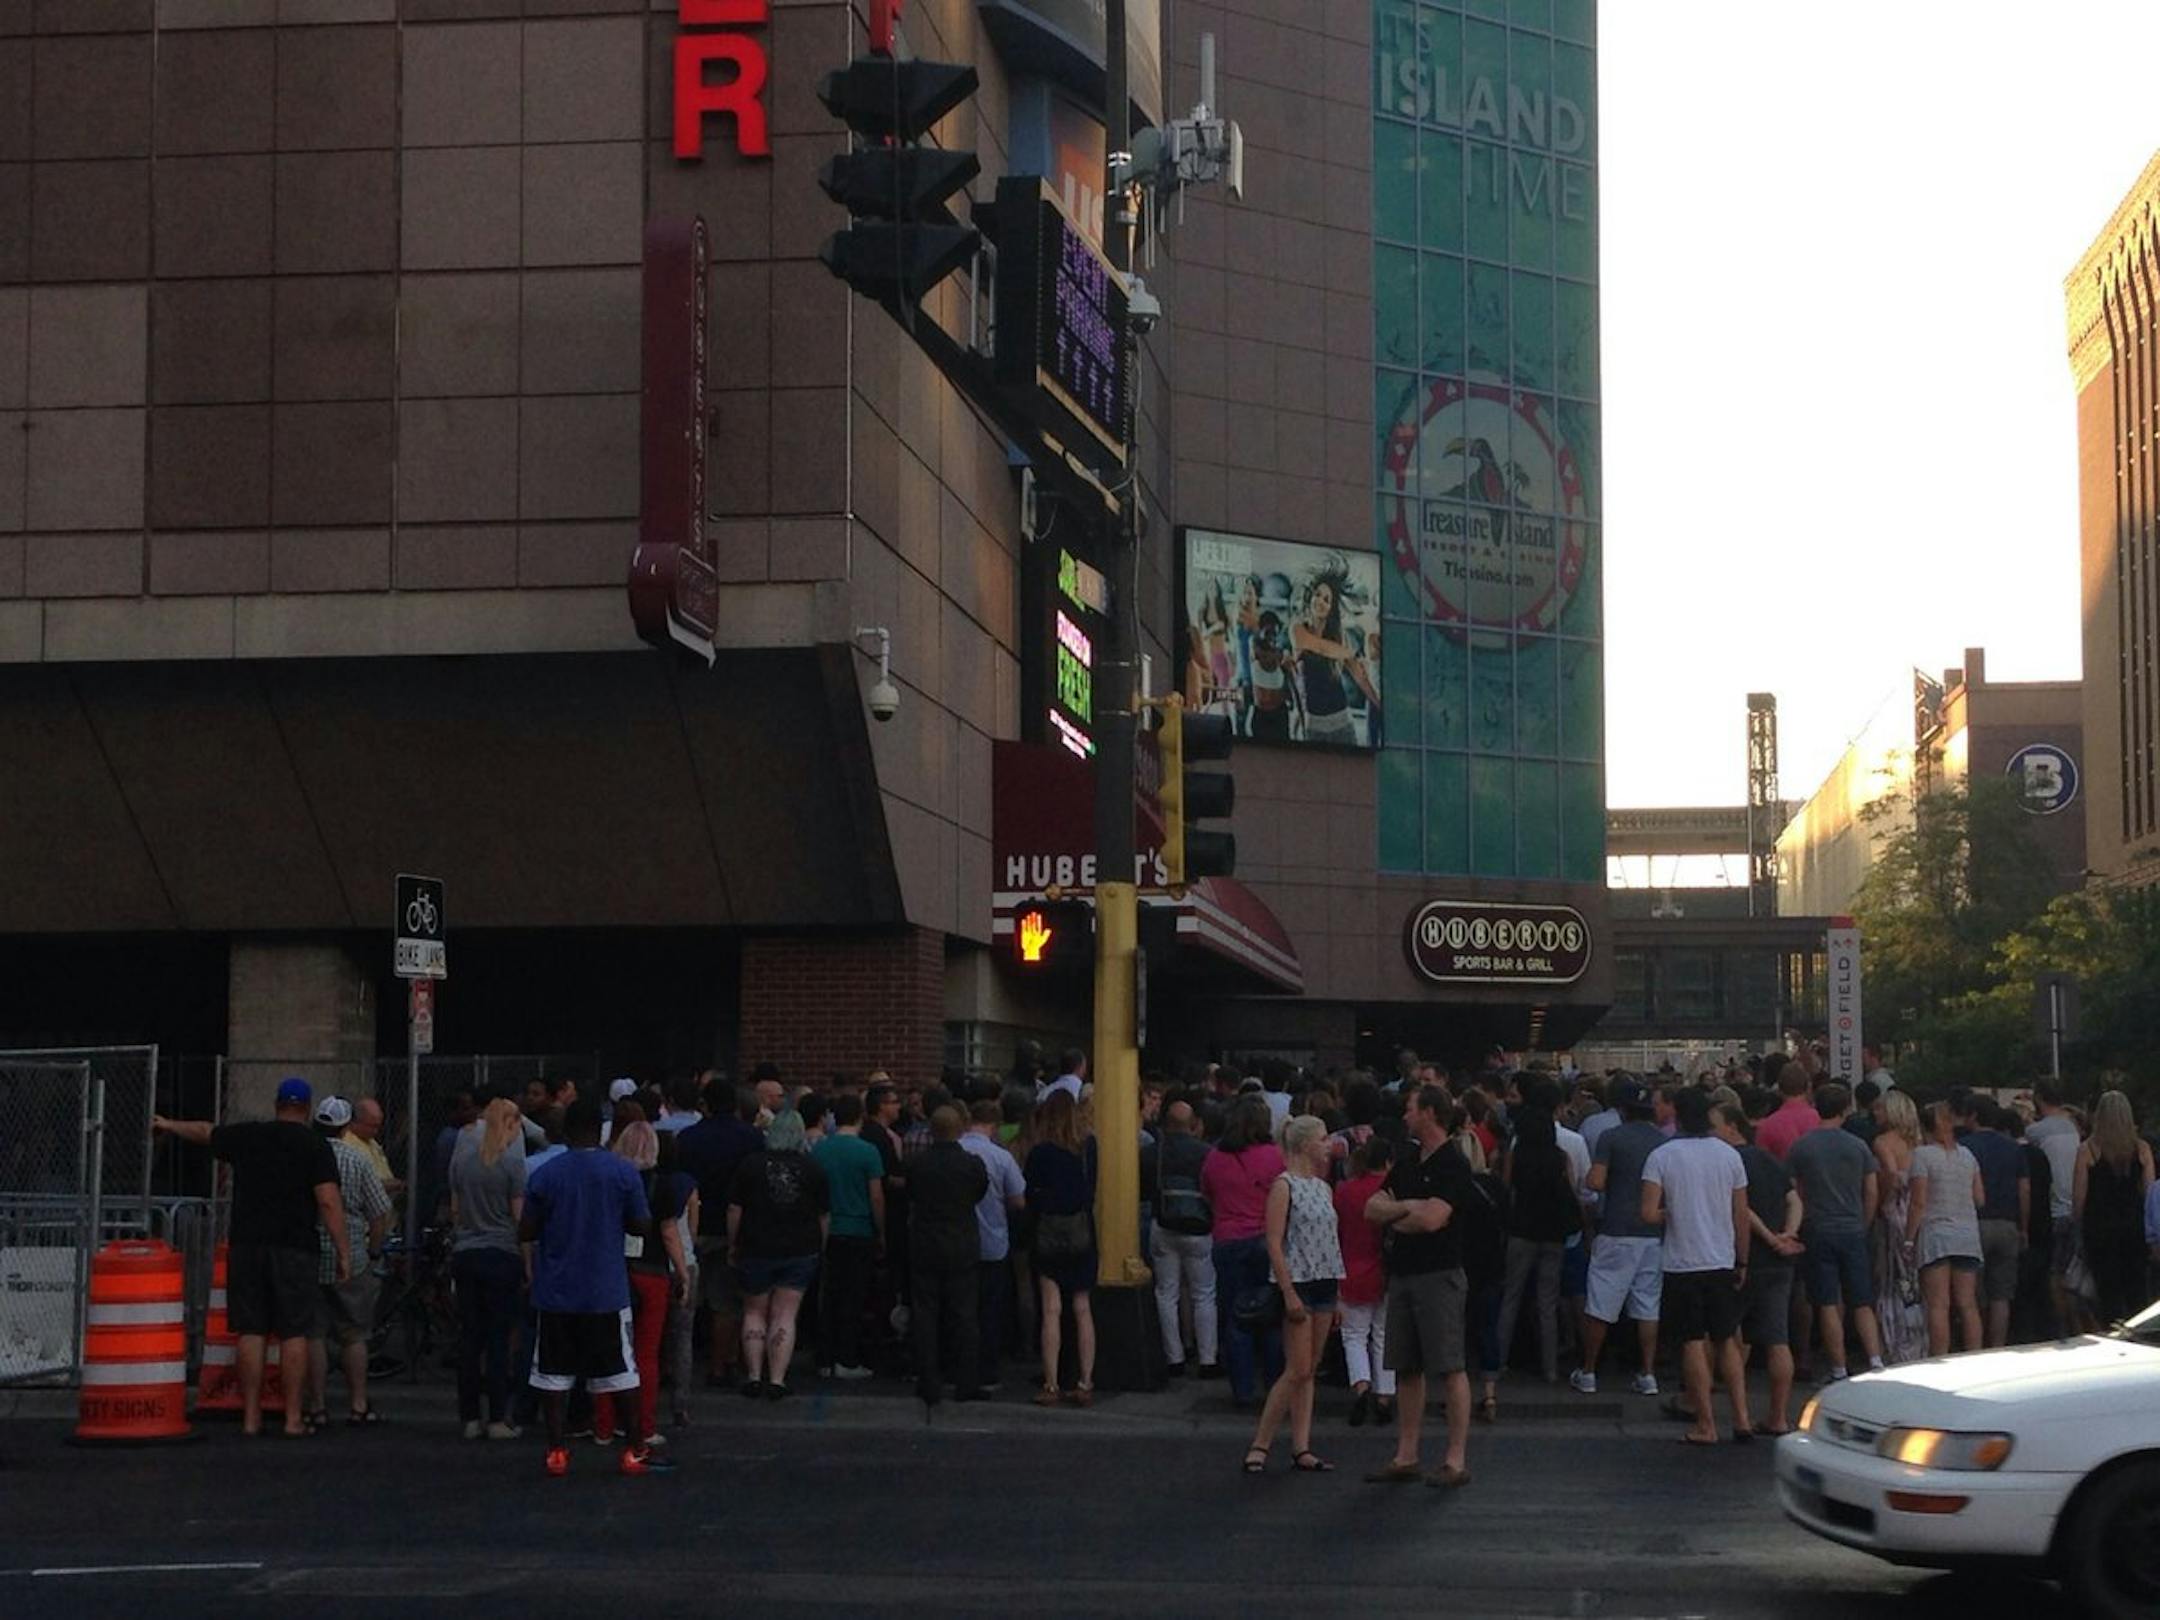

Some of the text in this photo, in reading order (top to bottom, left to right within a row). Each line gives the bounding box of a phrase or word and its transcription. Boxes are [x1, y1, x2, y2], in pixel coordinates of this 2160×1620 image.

[674, 0, 770, 158] R
[1380, 52, 1585, 153] ISLAND
[1453, 139, 1585, 220] TIME
[1423, 503, 1489, 540] Treasure
[1007, 848, 1168, 888] HUBET'S
[1423, 917, 1581, 950] HUBERTS
[1453, 955, 1553, 972] SPORTS BAR & GRILL
[1838, 956, 1852, 1013] FIELD
[112, 1398, 165, 1418] SIGNS
